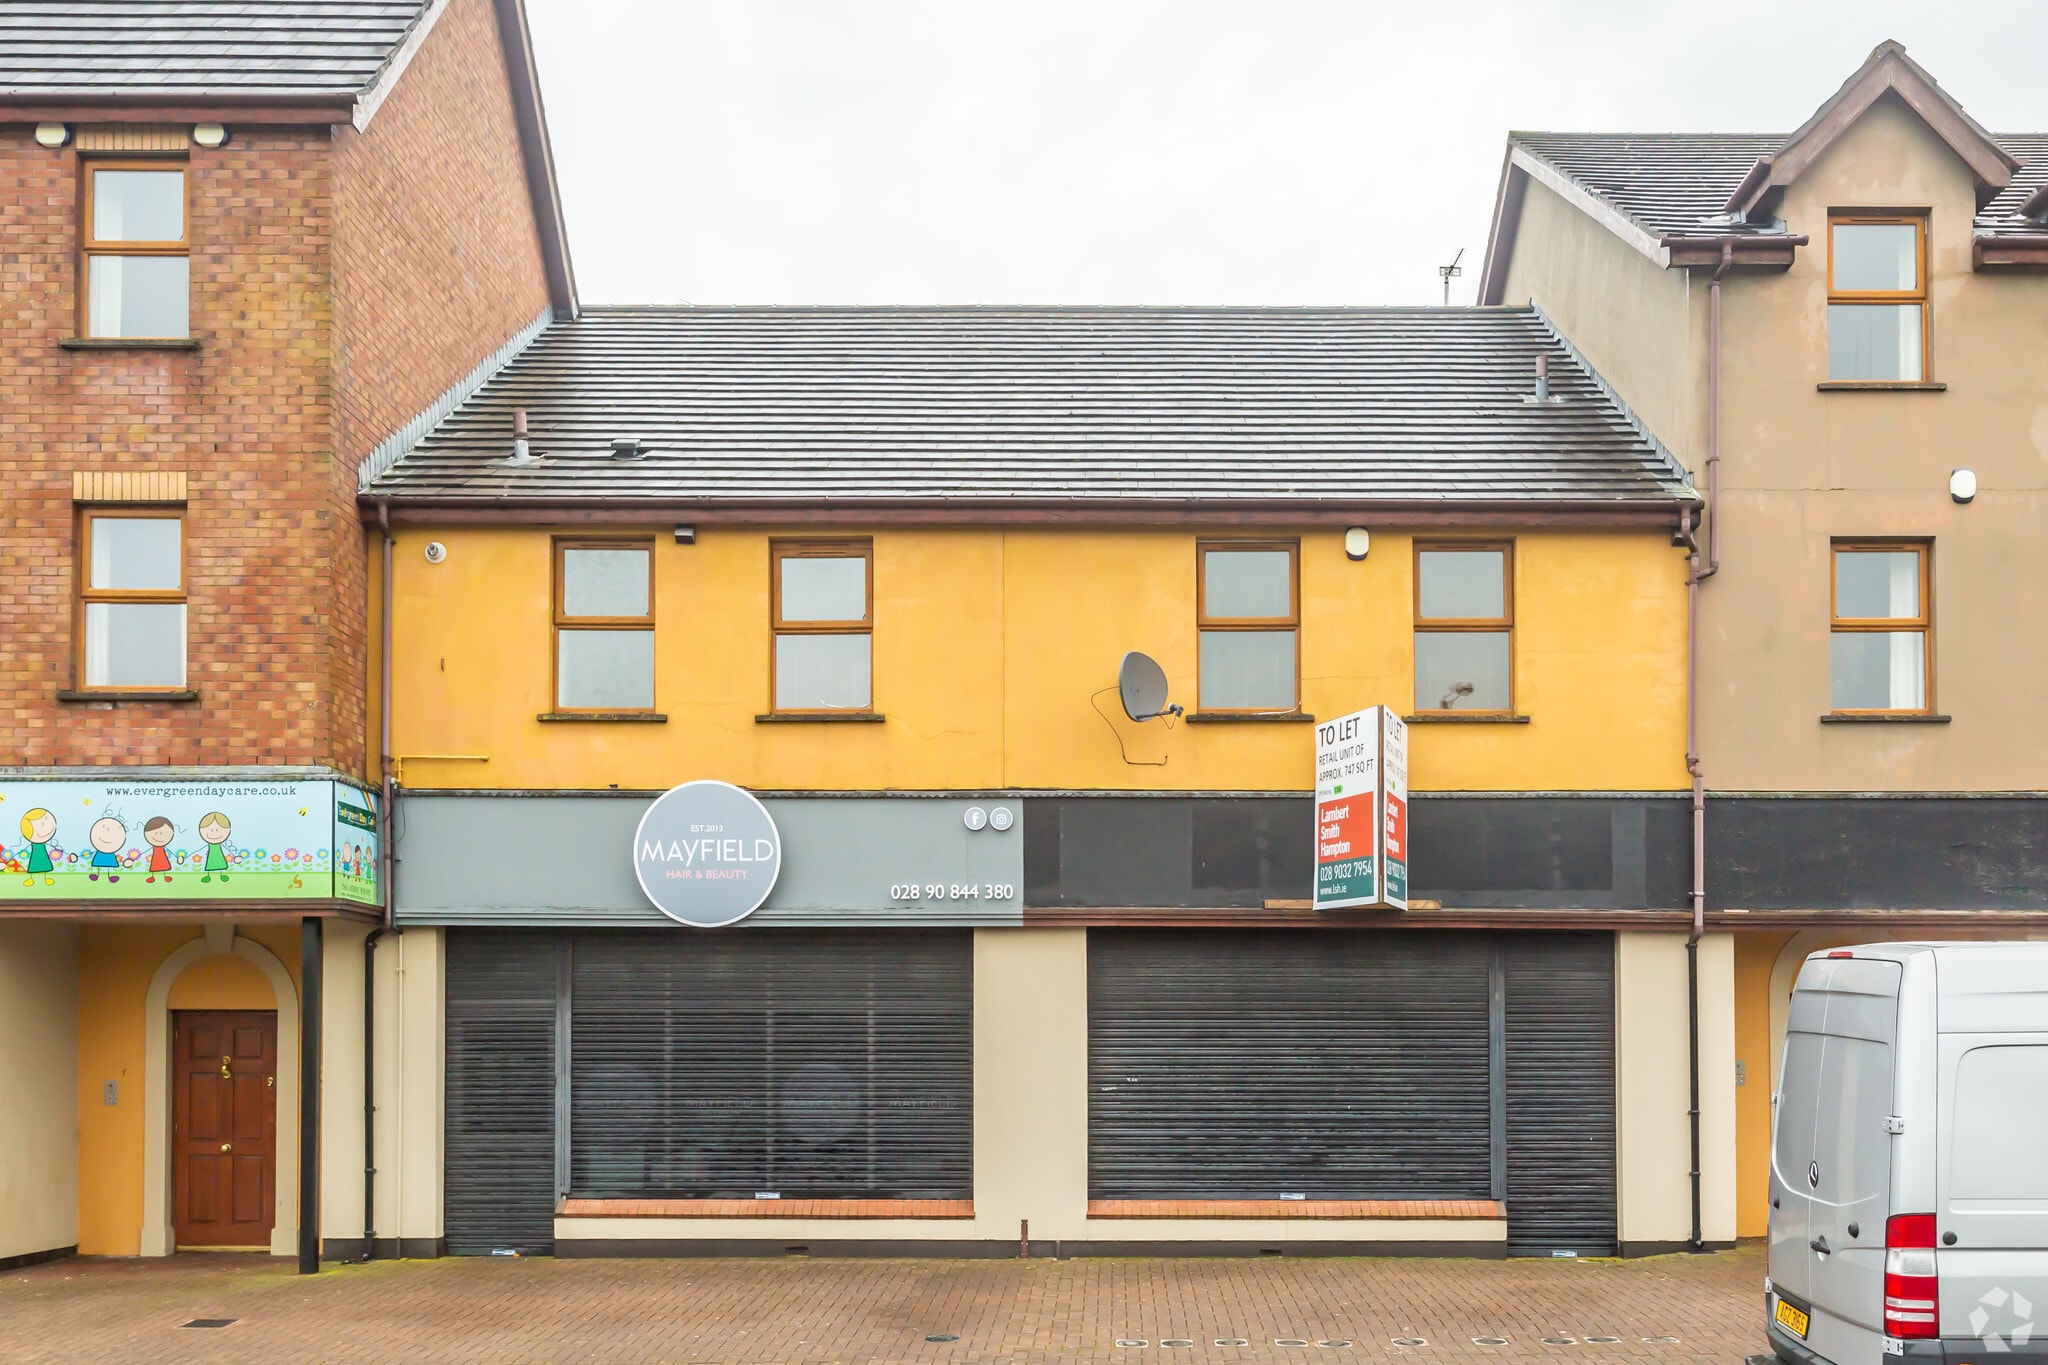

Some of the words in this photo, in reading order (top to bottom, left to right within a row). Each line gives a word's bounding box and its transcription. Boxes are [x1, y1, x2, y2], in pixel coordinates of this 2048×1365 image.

[1319, 725, 1335, 748] TO
[1339, 717, 1360, 742] LET
[1319, 751, 1338, 767] RETAIL
[1340, 746, 1354, 761] UNIT
[1355, 743, 1364, 756] OF
[1319, 767, 1343, 783] APPROX.
[1345, 763, 1355, 777] 747
[1356, 761, 1365, 774] SQ
[1366, 758, 1374, 771] FT
[106, 786, 297, 798] www.evergreendaycare.co.uk
[1321, 804, 1349, 823] Lambert
[1320, 823, 1340, 840] Smith
[641, 839, 774, 867] MAYFIELD
[1320, 840, 1350, 858] Hampton
[666, 869, 692, 879] HAIR
[695, 869, 703, 879] &
[706, 869, 748, 879] BEAUTY
[1320, 866, 1332, 882] 028
[1334, 862, 1352, 880] 9032
[1353, 860, 1373, 877] 7954
[890, 884, 920, 900] 028
[925, 884, 945, 900] 90
[950, 884, 979, 900] 844
[984, 884, 1014, 900] 380
[1319, 882, 1347, 896] www.lsh.ie
